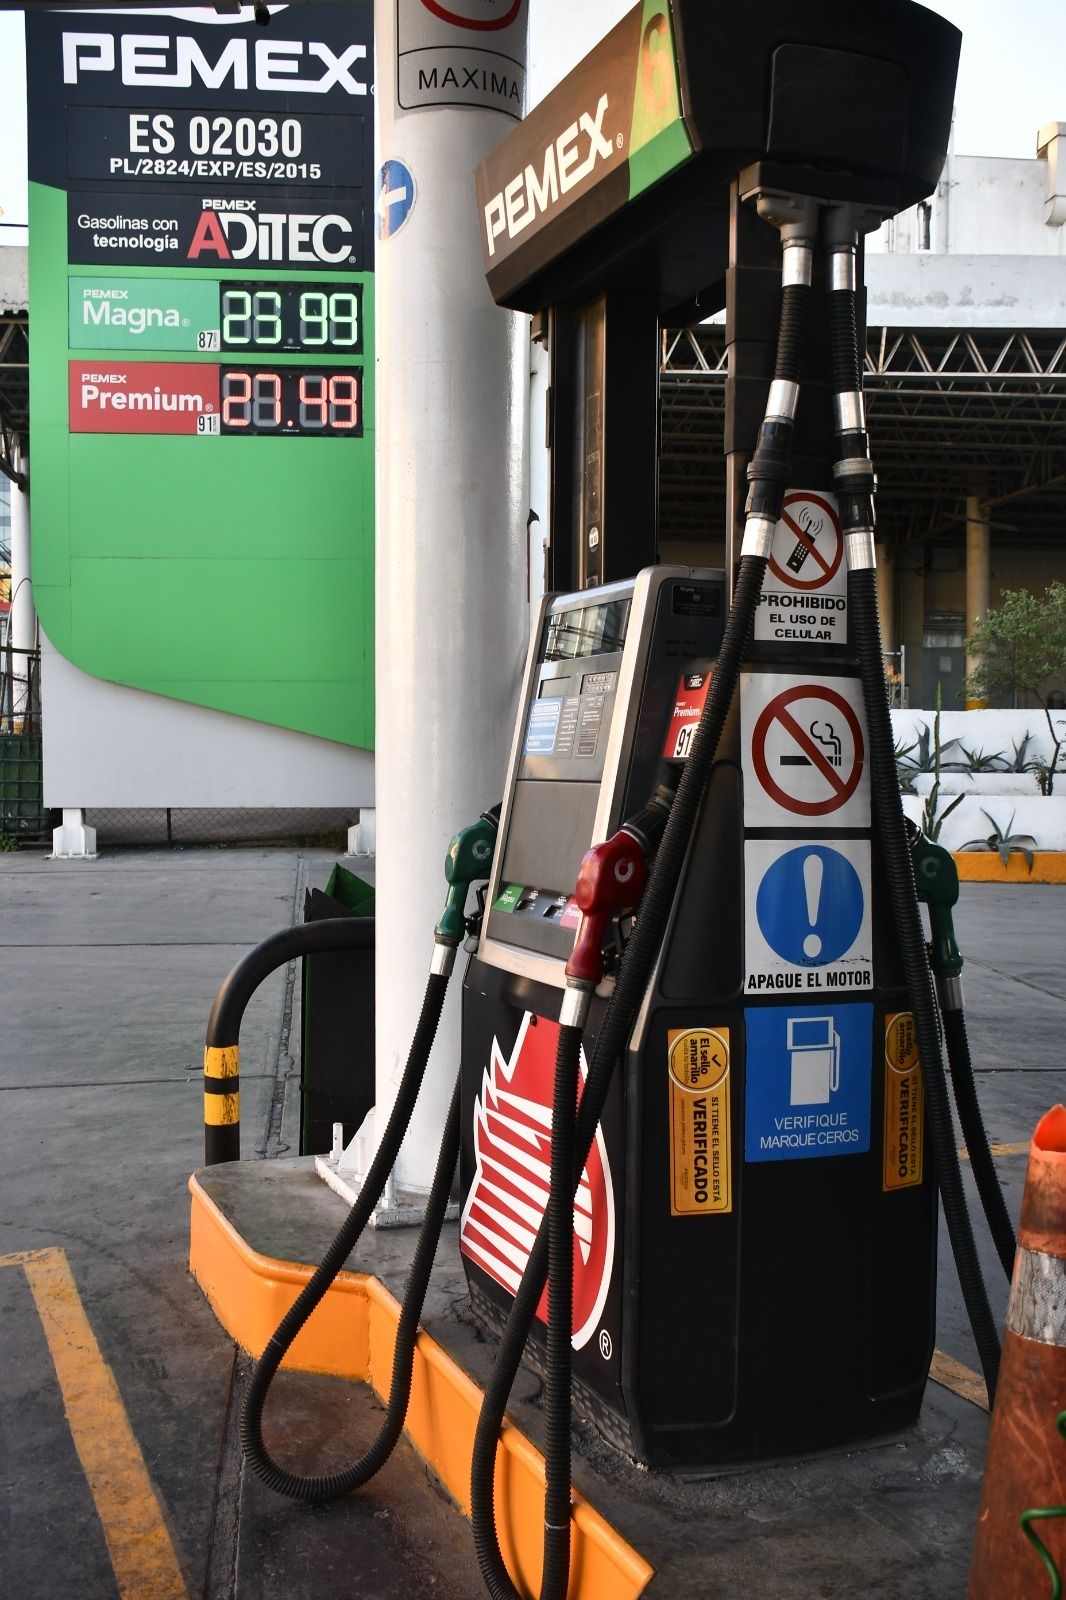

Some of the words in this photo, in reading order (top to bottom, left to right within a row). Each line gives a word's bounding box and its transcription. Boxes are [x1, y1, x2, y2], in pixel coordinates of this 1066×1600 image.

[62, 31, 367, 96] PEMEX
[418, 67, 520, 104] MAXIMA
[129, 114, 175, 155] ES
[189, 116, 302, 158] 02030
[110, 158, 321, 180] PL/2824/EXP/ES/2015
[484, 93, 614, 256] PEMEX
[202, 198, 256, 211] PEMEX
[77, 214, 149, 231] Gasolinas
[152, 219, 178, 231] con
[93, 233, 179, 252] tecnología
[83, 289, 128, 299] PEMEX
[82, 301, 180, 334] Magna
[198, 331, 213, 349] 87
[81, 373, 127, 384] PEMEX
[81, 386, 203, 412] Premium
[222, 373, 357, 428] 27.49
[198, 415, 213, 432] 91
[760, 594, 846, 611] PROHIBIDO
[769, 613, 785, 623] EL
[789, 614, 816, 625] USO
[820, 616, 836, 626] DE
[774, 628, 832, 640] CELULAR
[676, 728, 692, 756] 91
[747, 973, 802, 989] APAGUE
[807, 972, 822, 987] EL
[826, 970, 871, 987] MOTOR
[700, 1037, 711, 1048] El
[690, 1038, 701, 1084] amarillo
[700, 1049, 711, 1075] sello
[711, 1096, 719, 1107] SI
[711, 1108, 719, 1136] TIENE
[774, 1112, 848, 1130] VERIFIQUE
[898, 1077, 910, 1178] VERIFICADO
[712, 1138, 720, 1149] EL
[760, 1132, 816, 1149] MARQUE
[817, 1128, 859, 1145] CEROS
[693, 1097, 708, 1203] VERIFICADO
[712, 1150, 720, 1177] SELLO
[713, 1179, 721, 1202] ESTÁ
